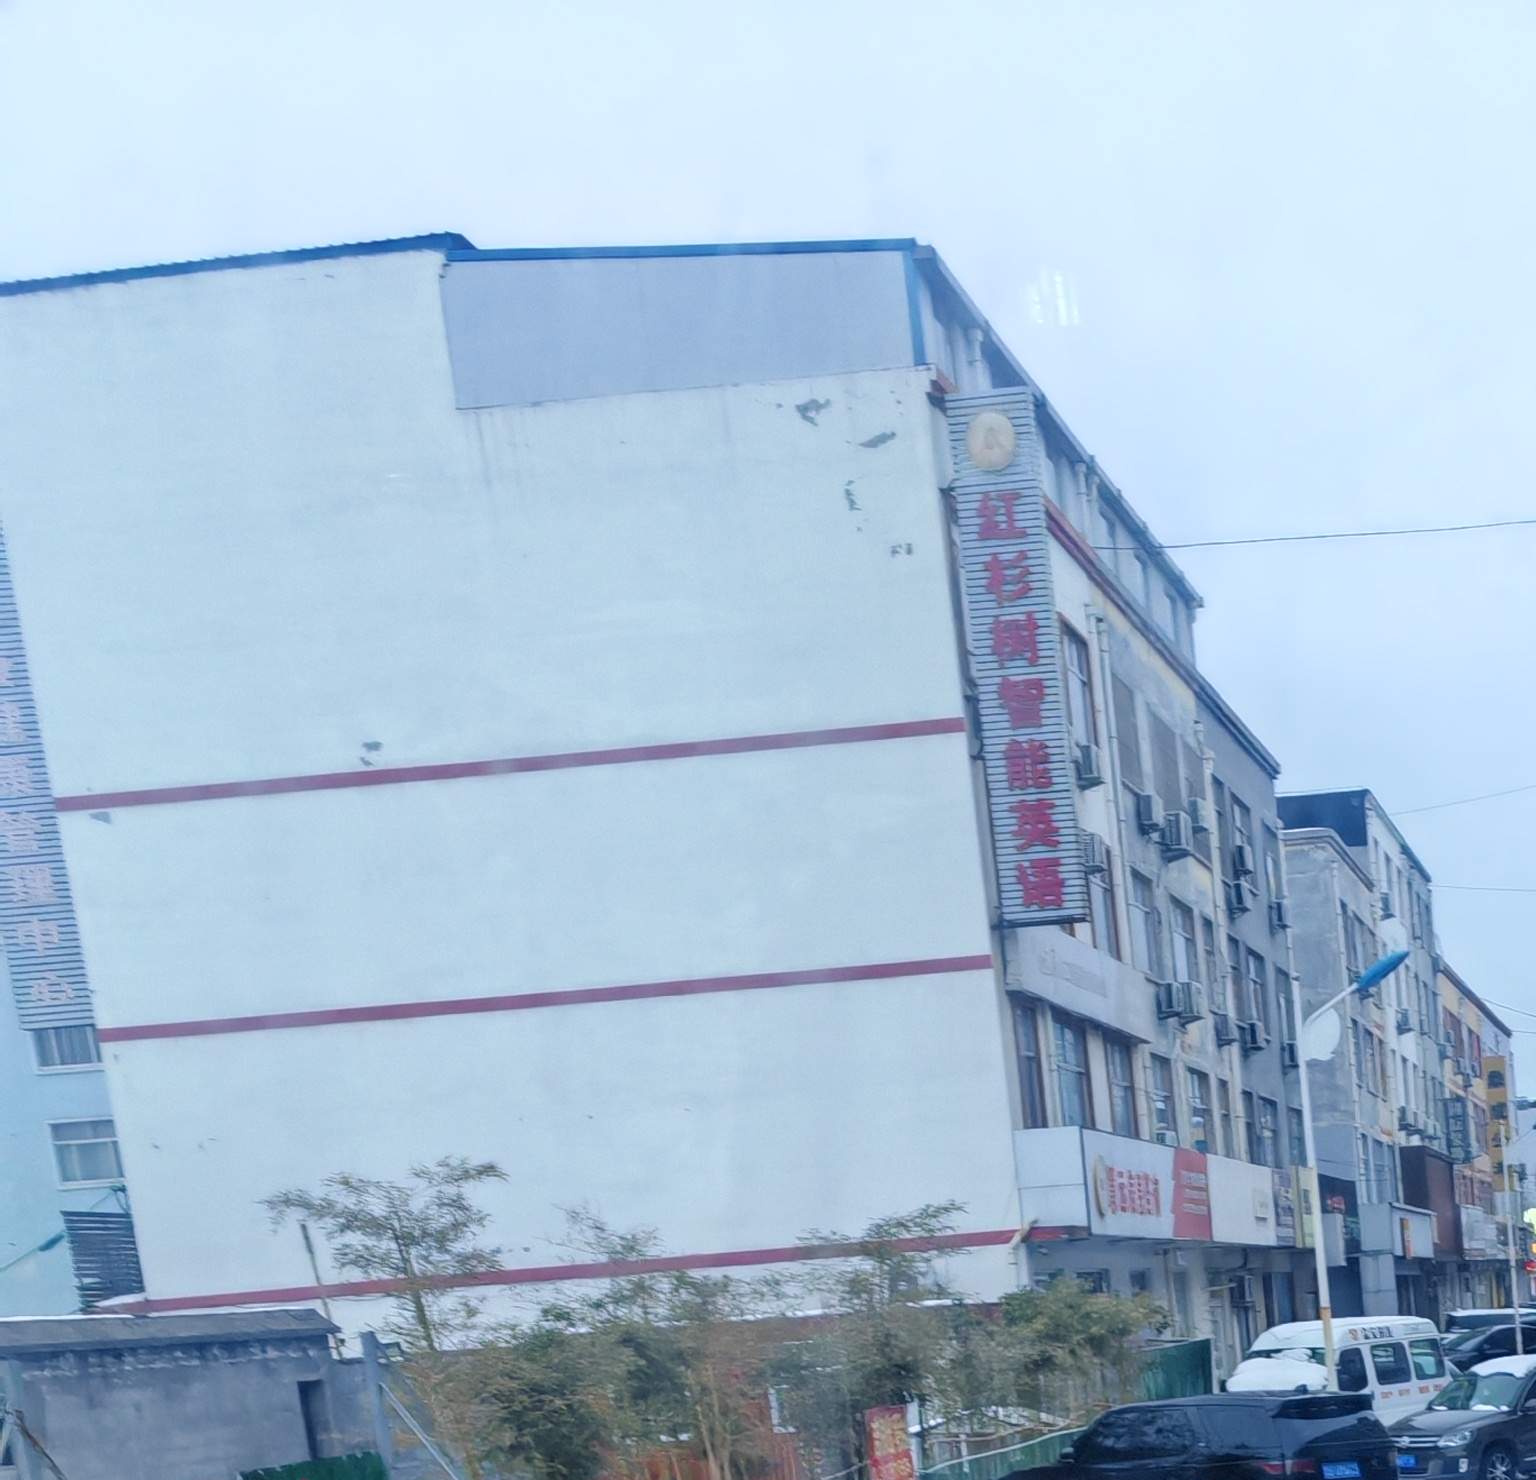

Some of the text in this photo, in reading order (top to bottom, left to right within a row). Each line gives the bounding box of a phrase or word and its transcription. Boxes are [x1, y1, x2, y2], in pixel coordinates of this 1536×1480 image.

[977, 490, 1065, 908] 红杉树智能英语
